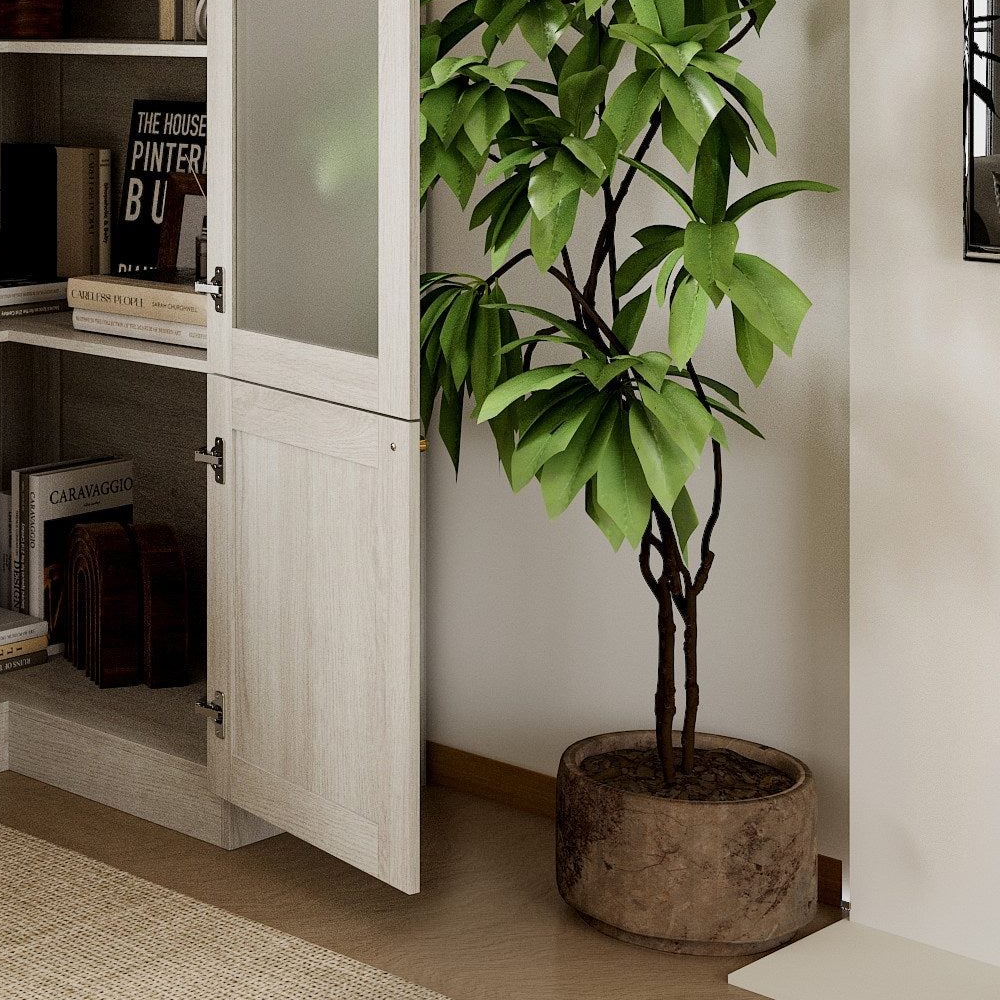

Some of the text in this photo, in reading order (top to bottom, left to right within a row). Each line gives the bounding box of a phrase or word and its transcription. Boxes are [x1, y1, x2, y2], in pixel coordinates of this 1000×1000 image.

[137, 111, 207, 137] THE HOUSE
[71, 289, 111, 302] CARELESS
[114, 295, 143, 308] PEOPLE
[50, 477, 133, 504] CARAVAGGIO
[13, 560, 21, 609] DESIGN
[3, 661, 12, 669] OF
[12, 657, 31, 667] RUINS
